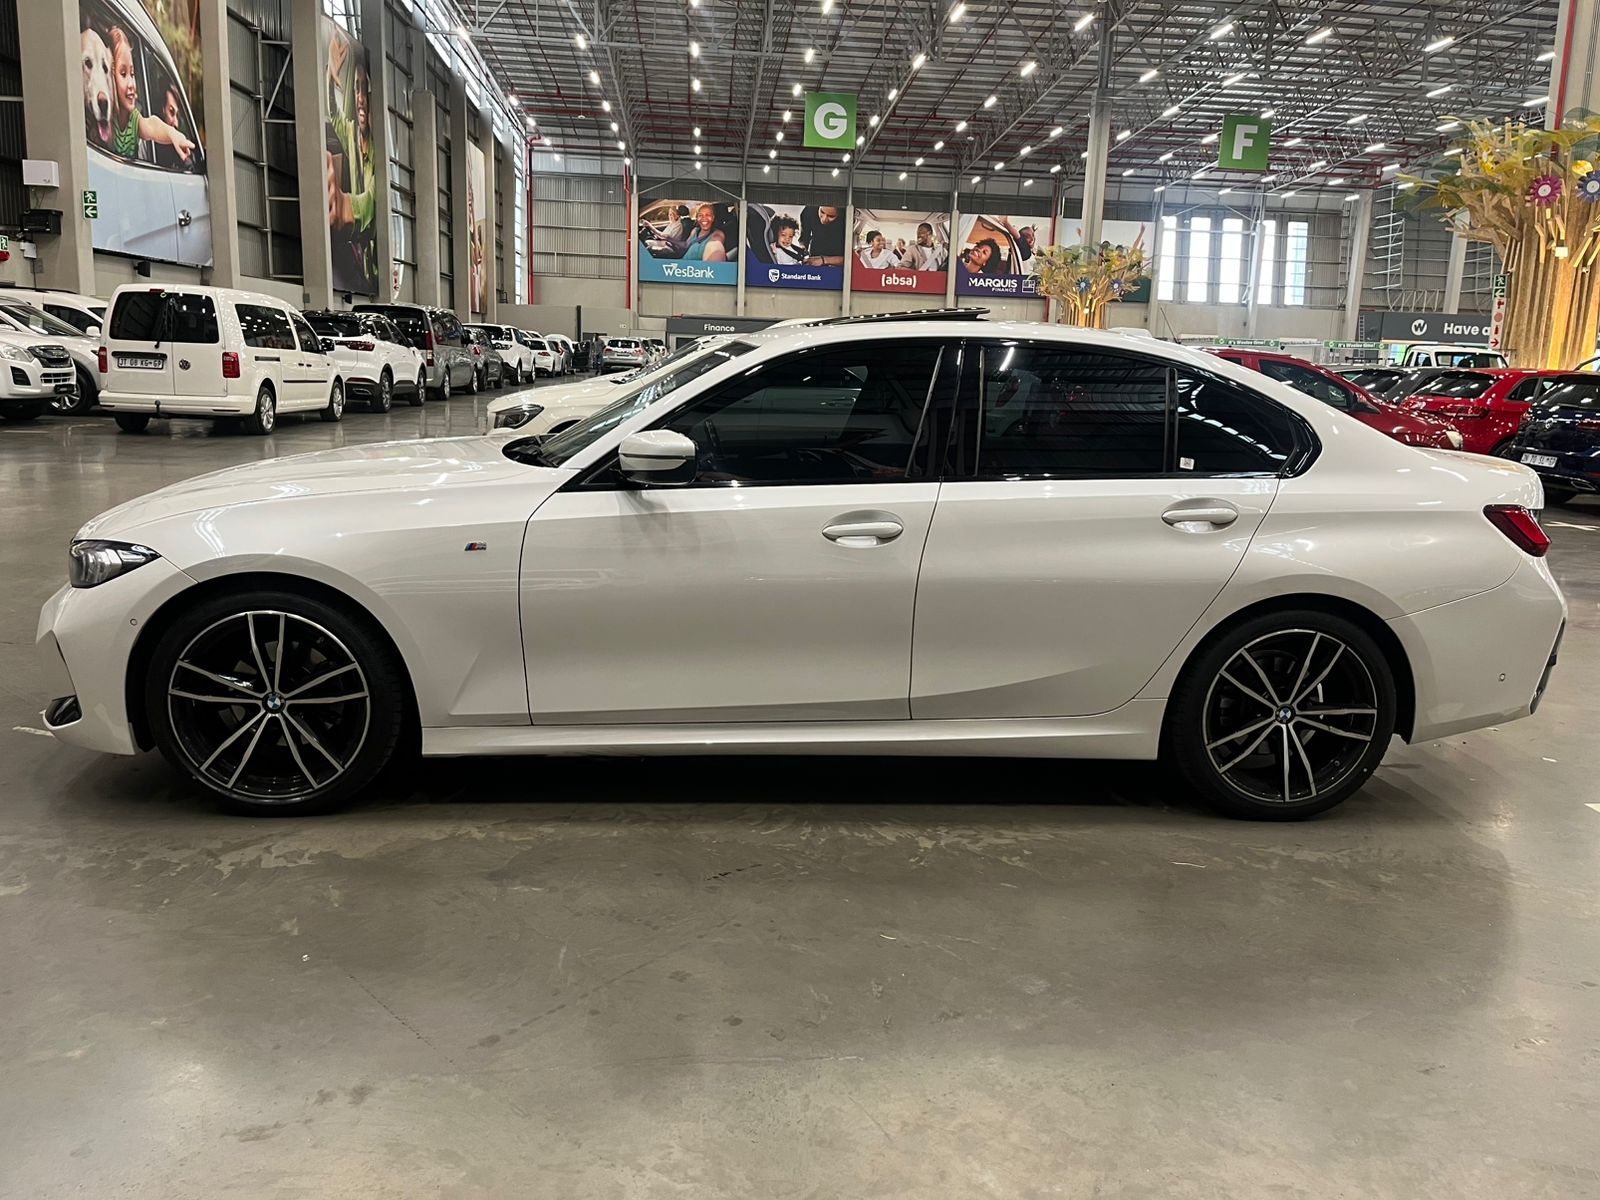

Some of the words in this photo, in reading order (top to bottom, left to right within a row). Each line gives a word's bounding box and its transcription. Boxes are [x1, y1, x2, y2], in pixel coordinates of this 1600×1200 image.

[814, 102, 848, 139] G
[1232, 124, 1258, 160] F
[662, 263, 714, 279] WesBank
[781, 272, 807, 281] Standard
[968, 277, 1018, 288] MARQUIS
[704, 323, 735, 332] Finance
[1443, 322, 1479, 336] Have
